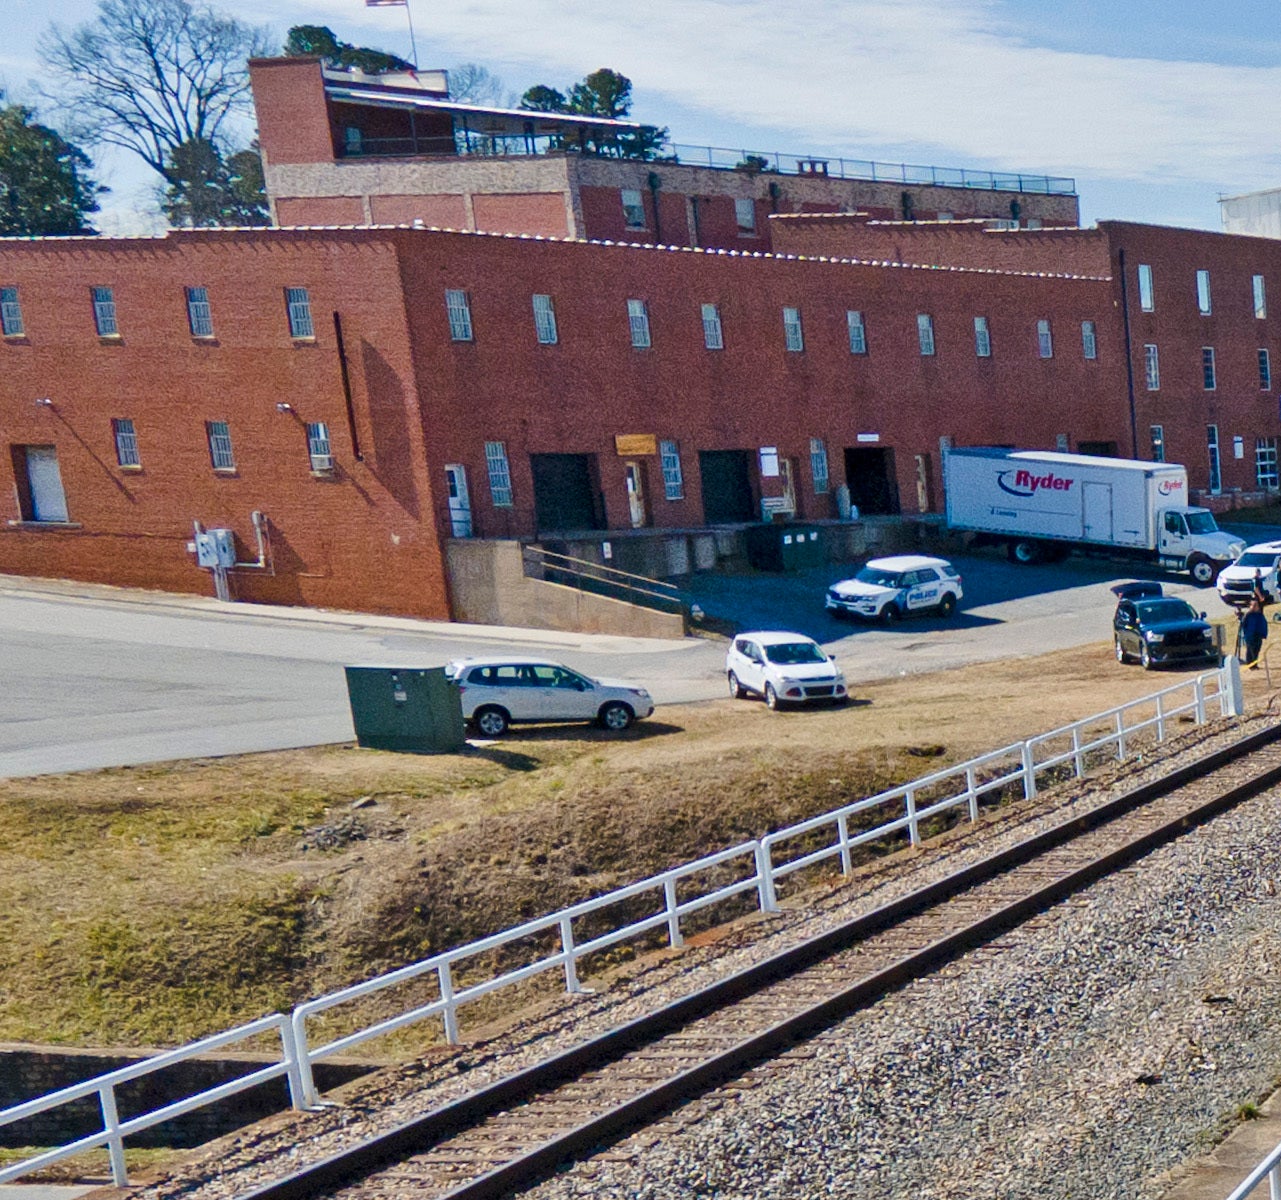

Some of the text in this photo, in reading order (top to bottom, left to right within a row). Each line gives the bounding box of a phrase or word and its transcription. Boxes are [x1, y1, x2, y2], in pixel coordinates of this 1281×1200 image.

[1016, 469, 1074, 492] Ryder
[1164, 480, 1183, 491] Ryder
[910, 589, 937, 600] POLICE
